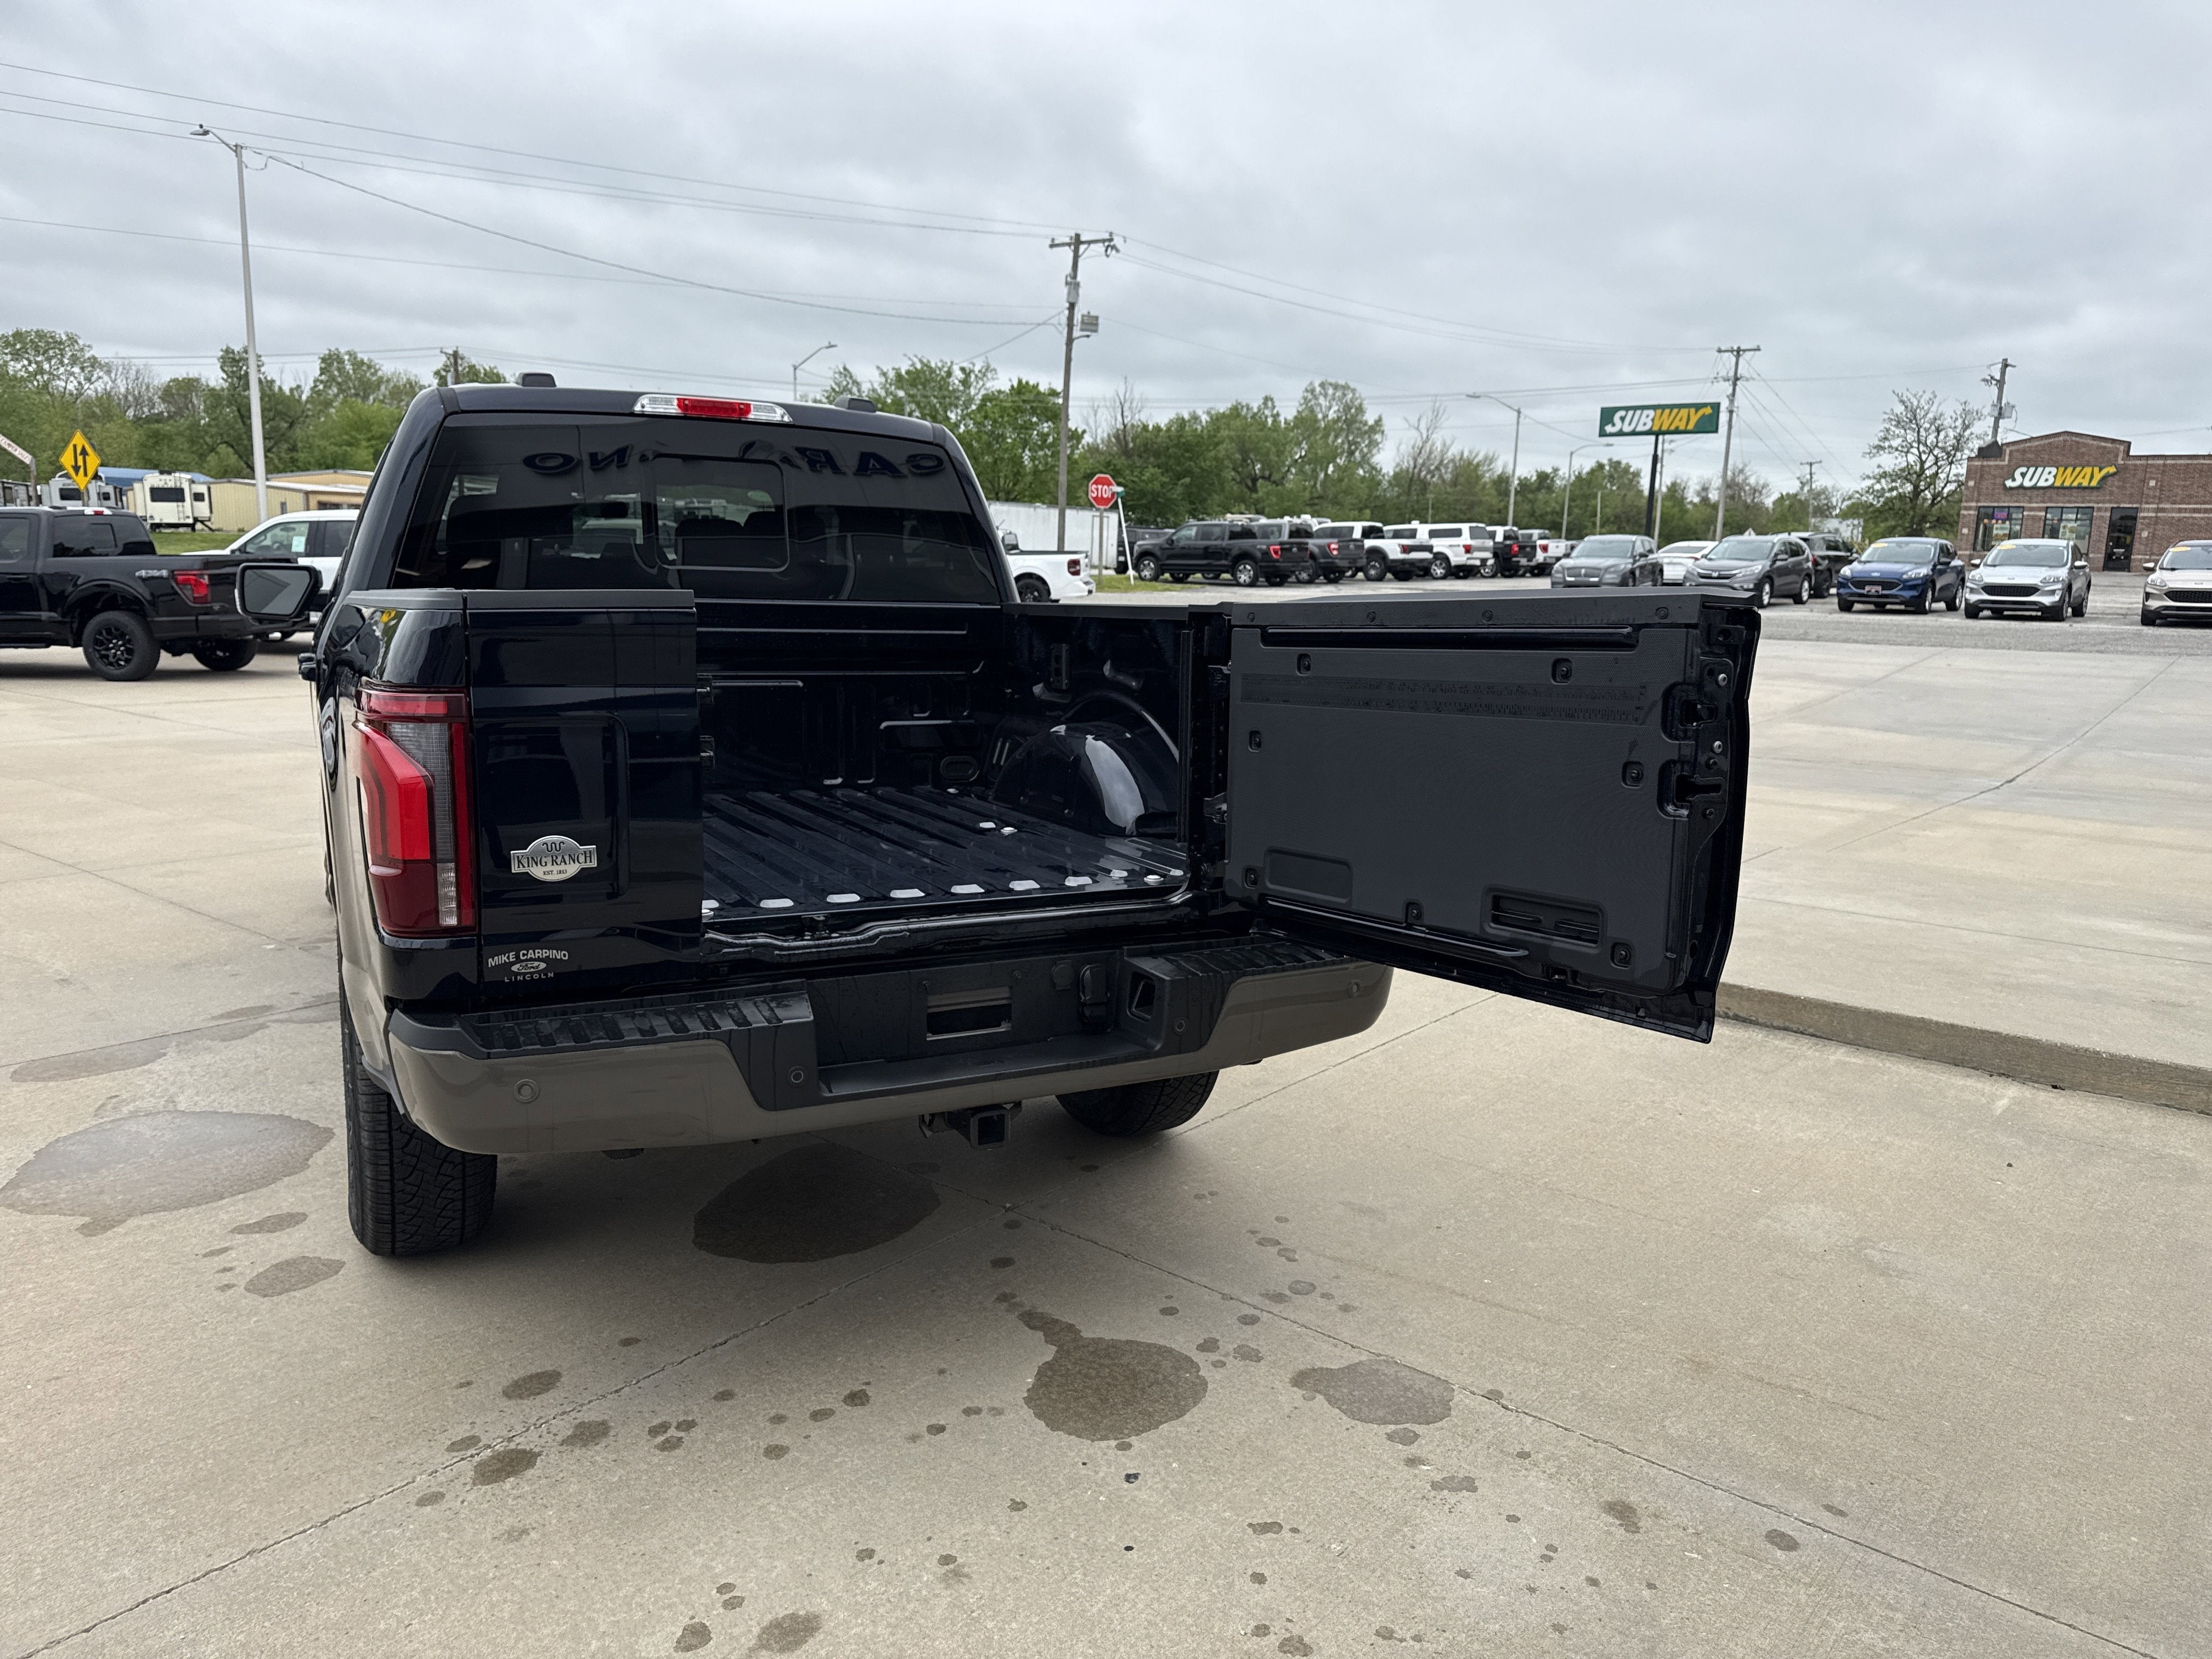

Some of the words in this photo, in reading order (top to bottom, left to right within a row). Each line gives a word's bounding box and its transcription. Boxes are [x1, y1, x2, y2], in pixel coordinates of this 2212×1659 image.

[1604, 405, 1712, 434] SUBWAY
[2005, 465, 2117, 488] SUBWAY
[517, 855, 548, 868] KING
[551, 850, 593, 866] RANCH
[488, 951, 516, 968] MIKE
[520, 949, 569, 960] CARPINO
[517, 962, 541, 971] Ford
[505, 972, 554, 982] LINCOLN
